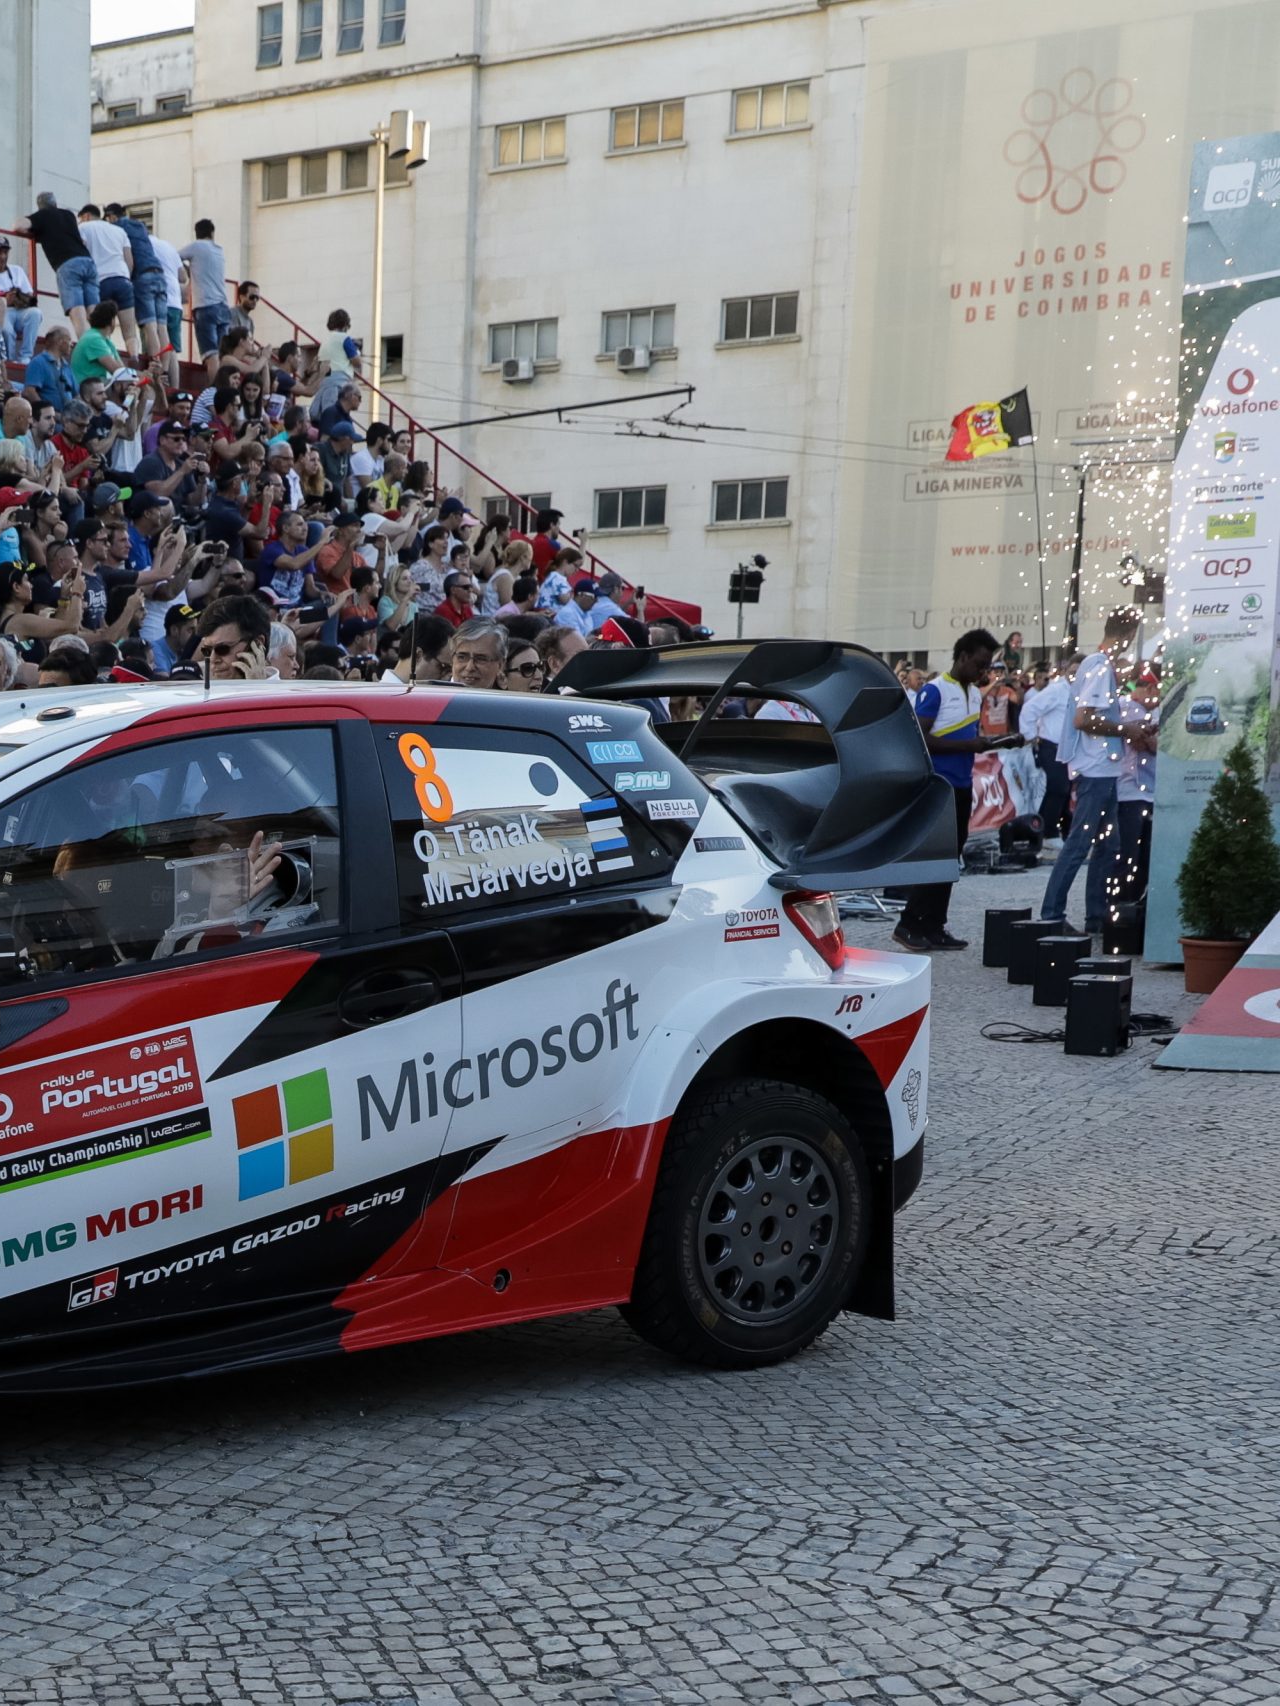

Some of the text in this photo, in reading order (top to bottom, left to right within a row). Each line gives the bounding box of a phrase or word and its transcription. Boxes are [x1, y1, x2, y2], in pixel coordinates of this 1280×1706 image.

[1212, 187, 1249, 204] acp
[1014, 242, 1106, 268] JOGOS
[950, 261, 1171, 300] UNIVERSIDADE
[965, 289, 1151, 323] DE COIMBRA
[1200, 399, 1279, 417] vodafone
[913, 429, 945, 443] LIGA
[916, 474, 1023, 494] LIGA MINERVA
[1203, 557, 1252, 578] acp
[1191, 603, 1230, 615] Hertz
[568, 715, 604, 729] SWS
[398, 732, 453, 823] 8
[650, 803, 695, 812] NISULA
[740, 908, 779, 922] TOYOTA
[726, 927, 778, 939] FINANCIAL SERVICES
[835, 994, 863, 1016] JTB
[145, 1034, 187, 1055] FIA WRC
[356, 978, 640, 1142] Microsoft
[40, 1069, 95, 1091] rally de
[42, 1057, 192, 1114] Portugal
[116, 1101, 132, 1110] CLUB
[140, 1090, 171, 1103] PORTUGAL
[172, 1081, 194, 1095] 2019
[11, 1157, 46, 1178] Rally
[48, 1131, 143, 1167] Championship
[86, 1184, 204, 1242] MORI
[71, 1186, 406, 1308] GR TOYOTA GAZOO Racing
